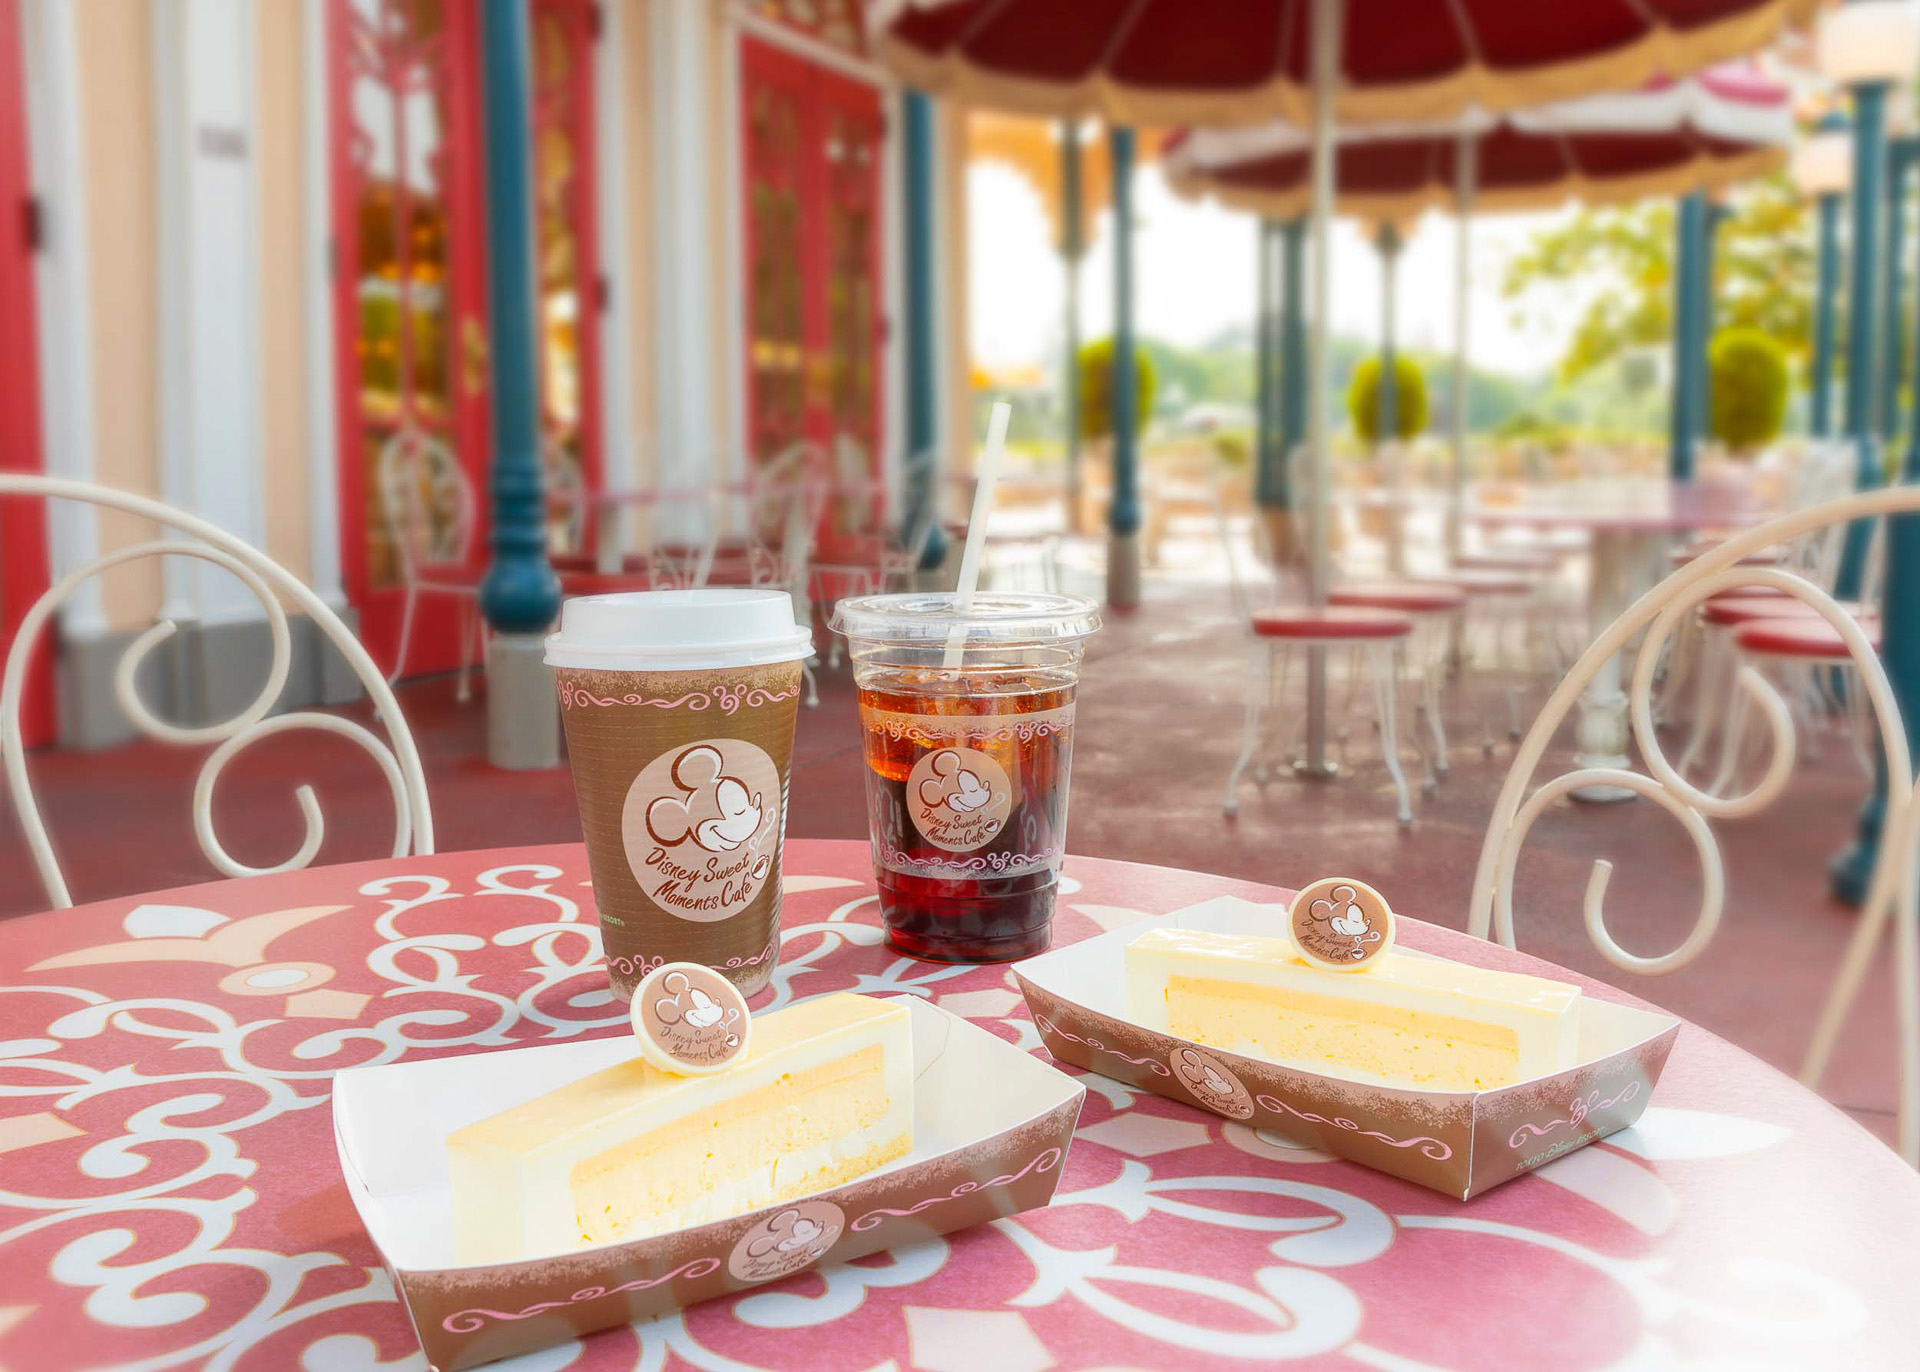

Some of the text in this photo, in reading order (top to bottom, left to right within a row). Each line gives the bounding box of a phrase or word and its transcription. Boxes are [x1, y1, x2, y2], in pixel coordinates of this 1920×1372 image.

[920, 808, 982, 834] Disney Sweet
[925, 827, 962, 846] Moments
[645, 847, 750, 893] Disney Sweet
[652, 879, 719, 910] Moments
